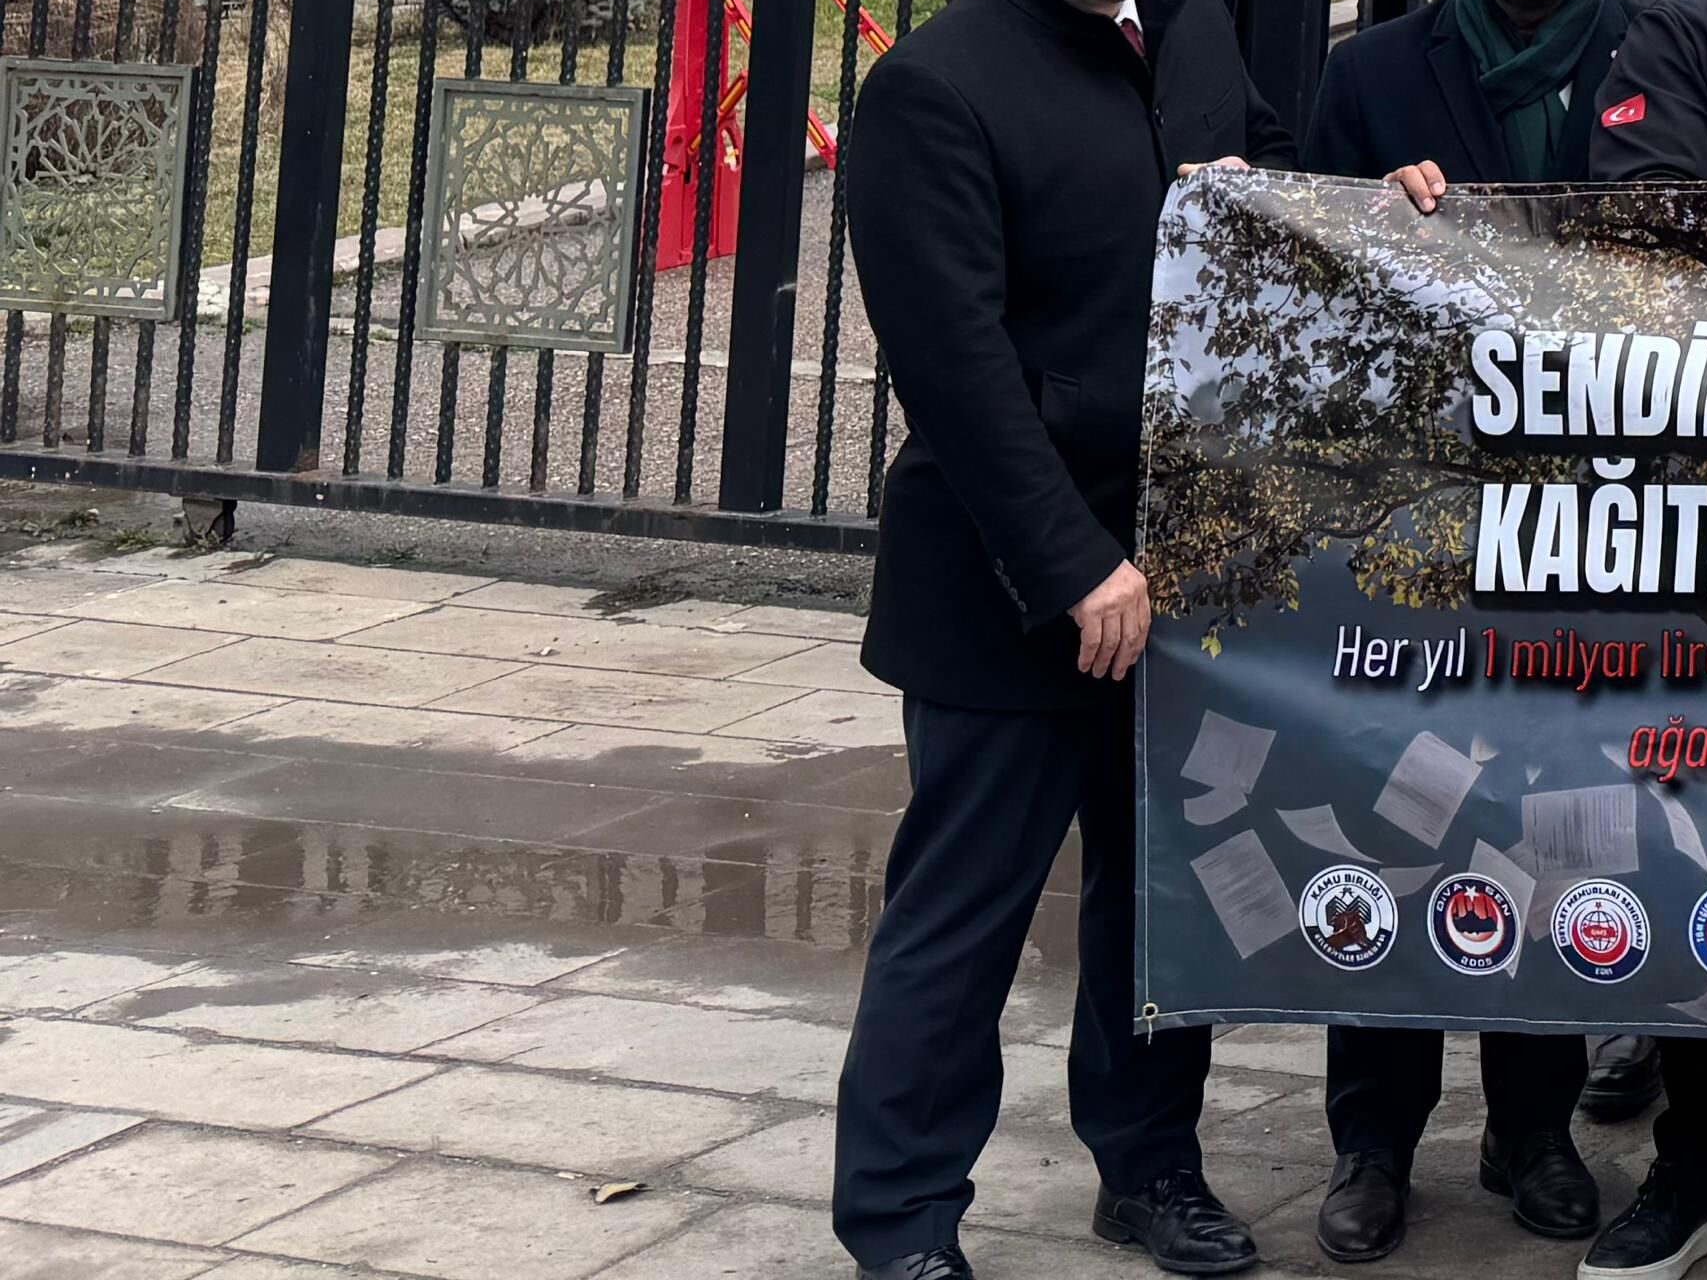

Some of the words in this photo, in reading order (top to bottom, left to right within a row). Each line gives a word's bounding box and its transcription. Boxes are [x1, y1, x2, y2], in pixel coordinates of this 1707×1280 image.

[1333, 624, 1409, 679] Her
[1416, 625, 1467, 692] yıl
[1482, 628, 1496, 679] 1
[1510, 627, 1647, 692] milyar
[1310, 874, 1341, 901] KAMU
